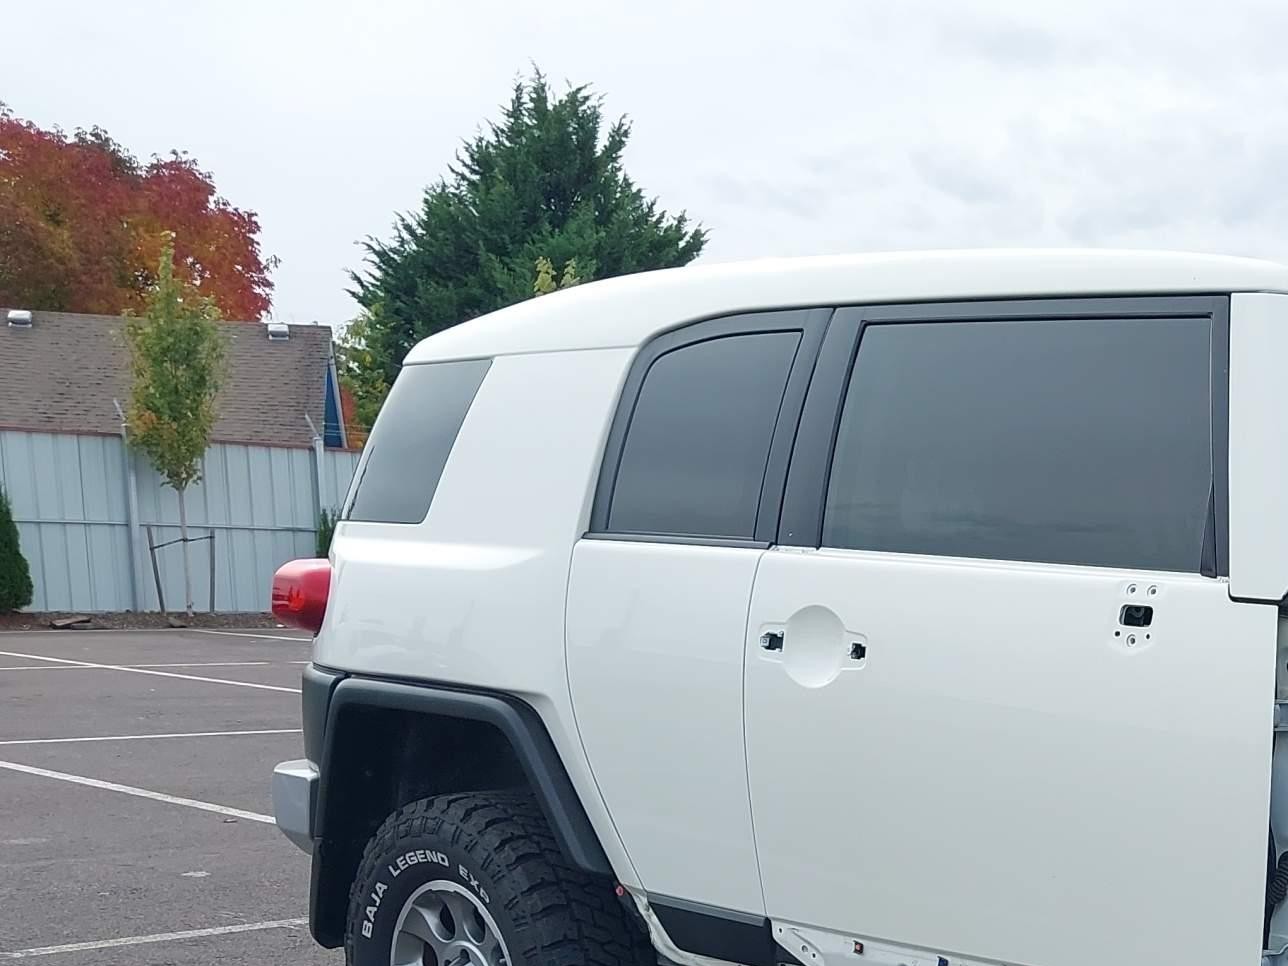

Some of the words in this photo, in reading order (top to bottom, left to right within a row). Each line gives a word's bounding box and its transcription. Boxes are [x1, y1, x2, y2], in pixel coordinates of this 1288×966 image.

[362, 882, 388, 939] BAJA
[388, 849, 449, 877] LEGEND
[458, 864, 489, 904] EXP
